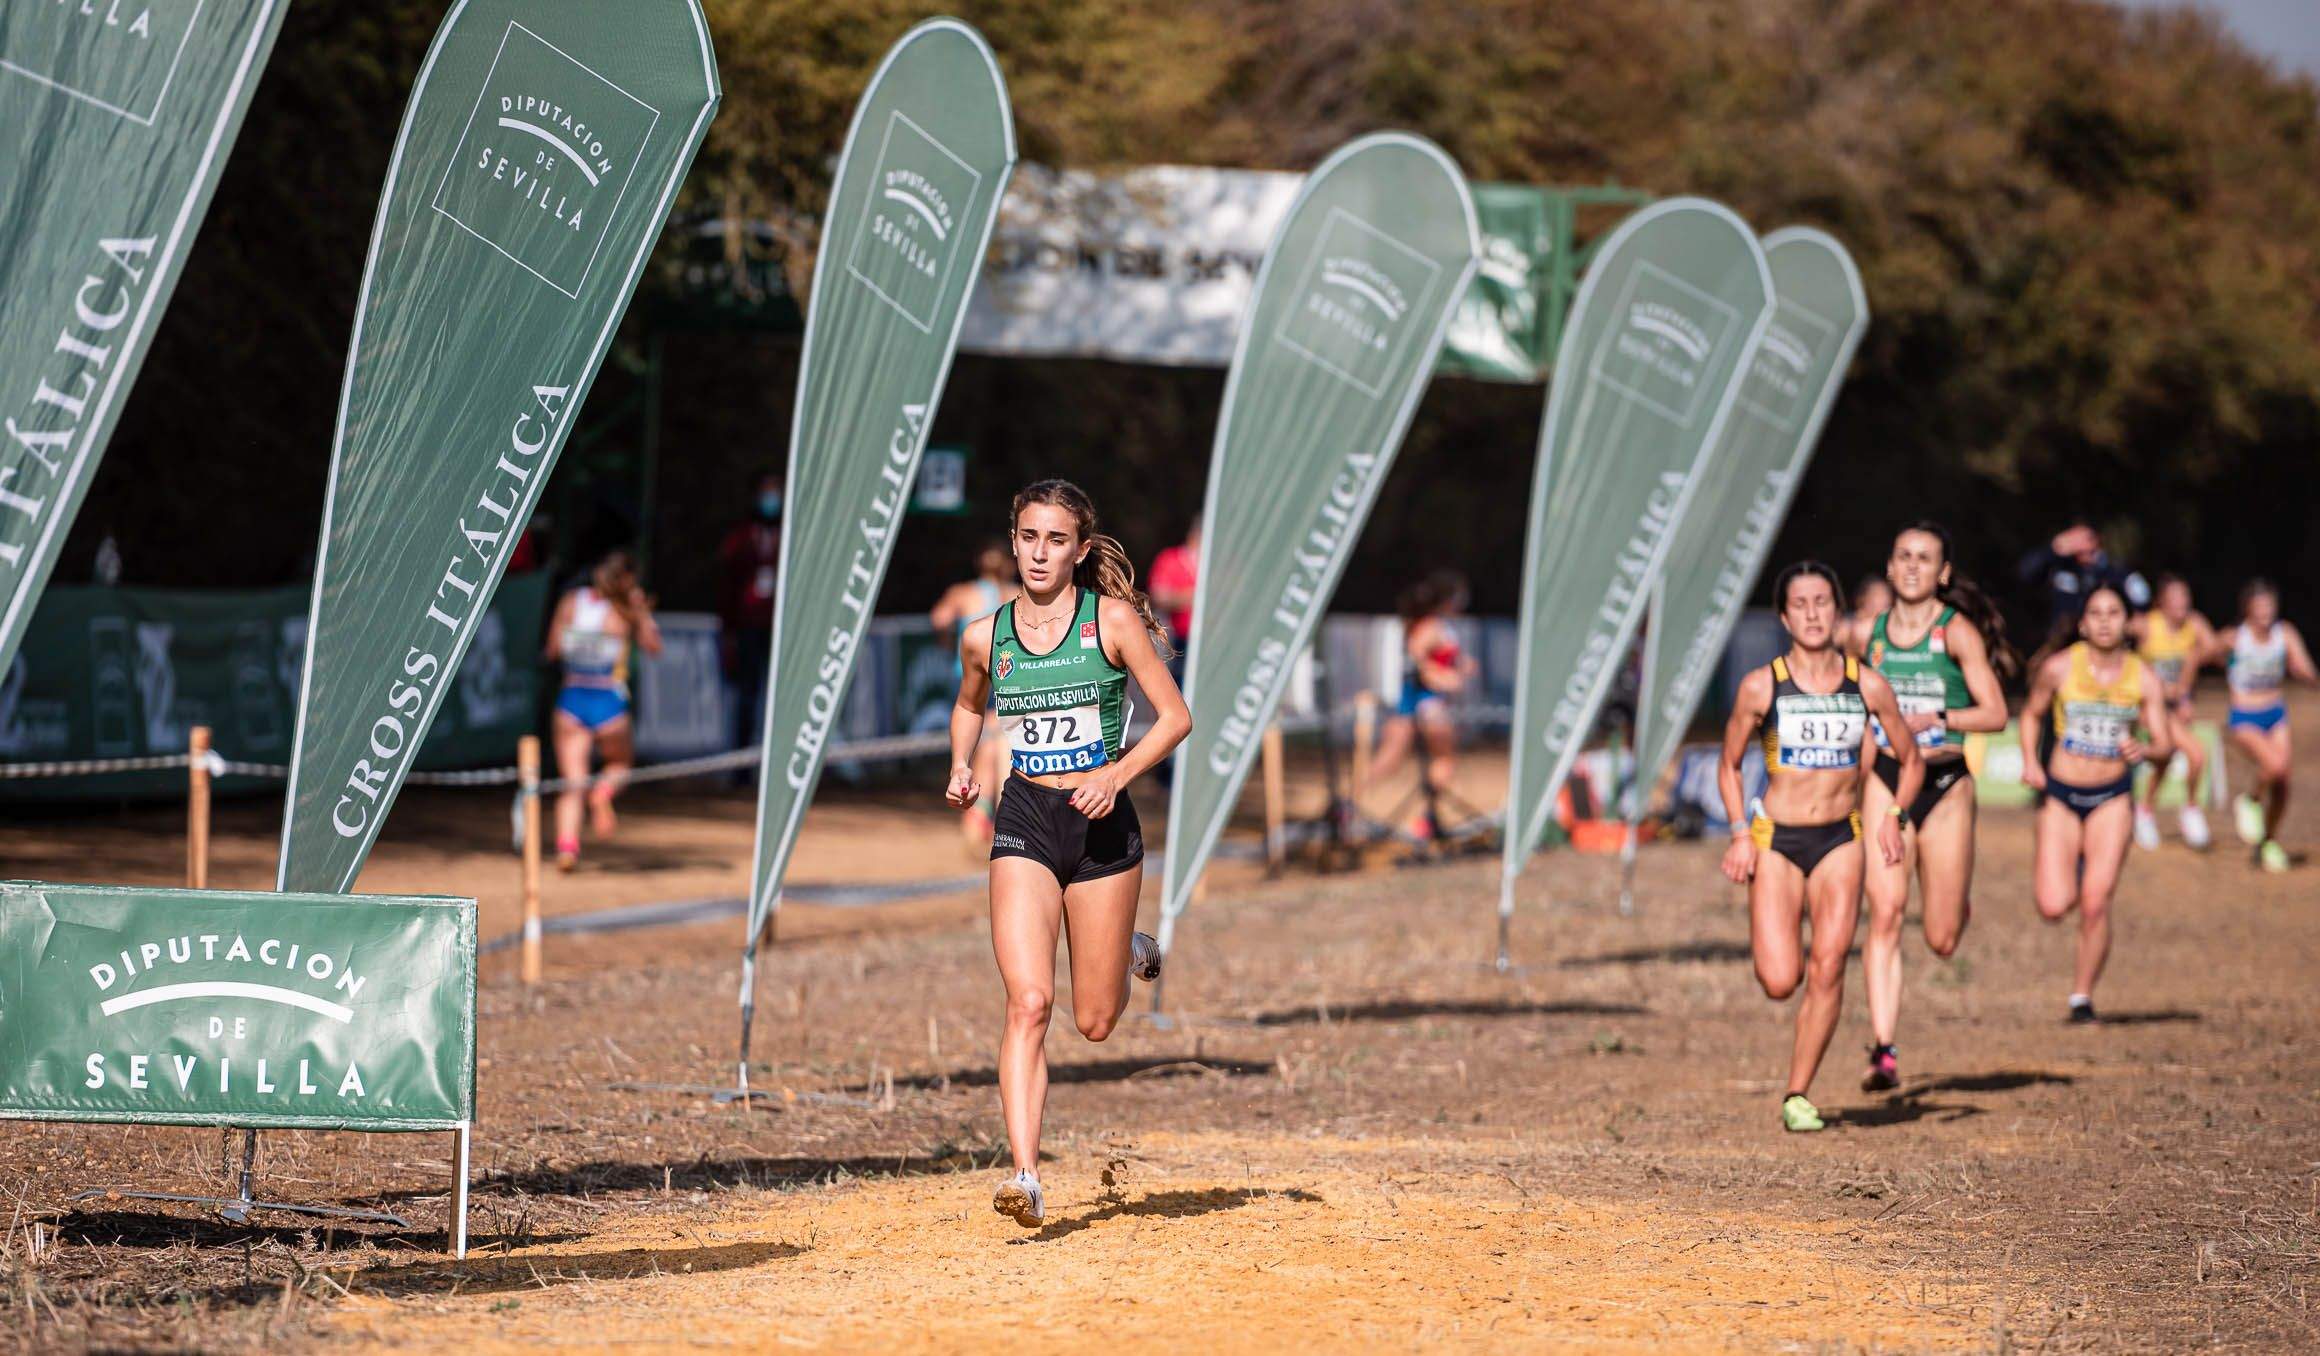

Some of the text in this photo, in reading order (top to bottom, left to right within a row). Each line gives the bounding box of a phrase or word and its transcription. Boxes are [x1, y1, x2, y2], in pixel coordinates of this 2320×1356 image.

[501, 95, 612, 175] DIPUTACION
[536, 151, 555, 171] DE
[479, 147, 583, 231] SEVILLA
[873, 214, 936, 277] SEVILLA
[332, 384, 570, 838] CROSS ITÁLICA
[786, 403, 927, 790] CROSS ITÁLICA
[1210, 452, 1375, 776] CROSS ITÁLICA
[1020, 657, 1072, 670] VILLARREAL
[998, 694, 1047, 711] DIPUTACION
[1048, 693, 1061, 706] DE
[1062, 686, 1098, 705] SEVILLA
[1023, 716, 1080, 745] 872
[1801, 720, 1848, 741] 812
[89, 935, 366, 998] DIPUTACION
[209, 1017, 246, 1039] DE
[85, 1052, 365, 1097] SEVILLA
